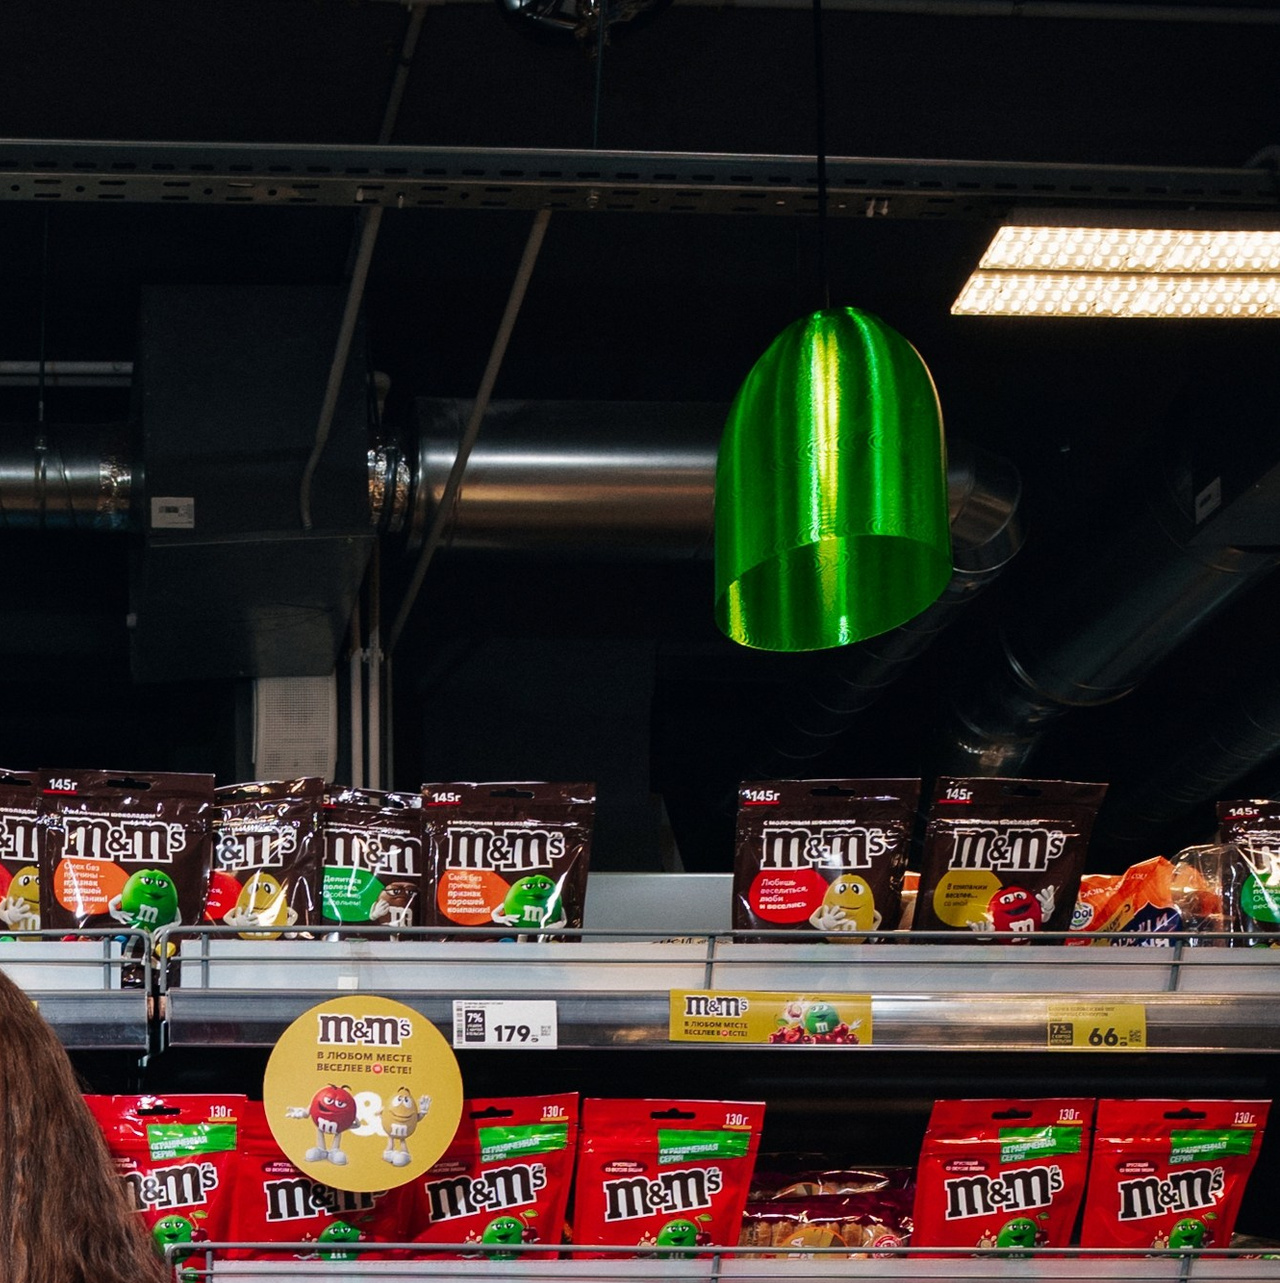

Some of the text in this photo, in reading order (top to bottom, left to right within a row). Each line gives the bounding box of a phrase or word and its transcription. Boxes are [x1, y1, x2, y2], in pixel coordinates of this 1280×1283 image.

[49, 778, 78, 791] 145г
[432, 793, 461, 802] 145г
[946, 788, 973, 801] 145г
[467, 1013, 483, 1023] 7%
[494, 1025, 531, 1043] 179
[1088, 1028, 1119, 1046] 66
[328, 1052, 373, 1061] ЛЮБОМ
[377, 1054, 412, 1063] МЕСТЕ
[317, 1064, 363, 1072] ВЕСЕЛЕЕ
